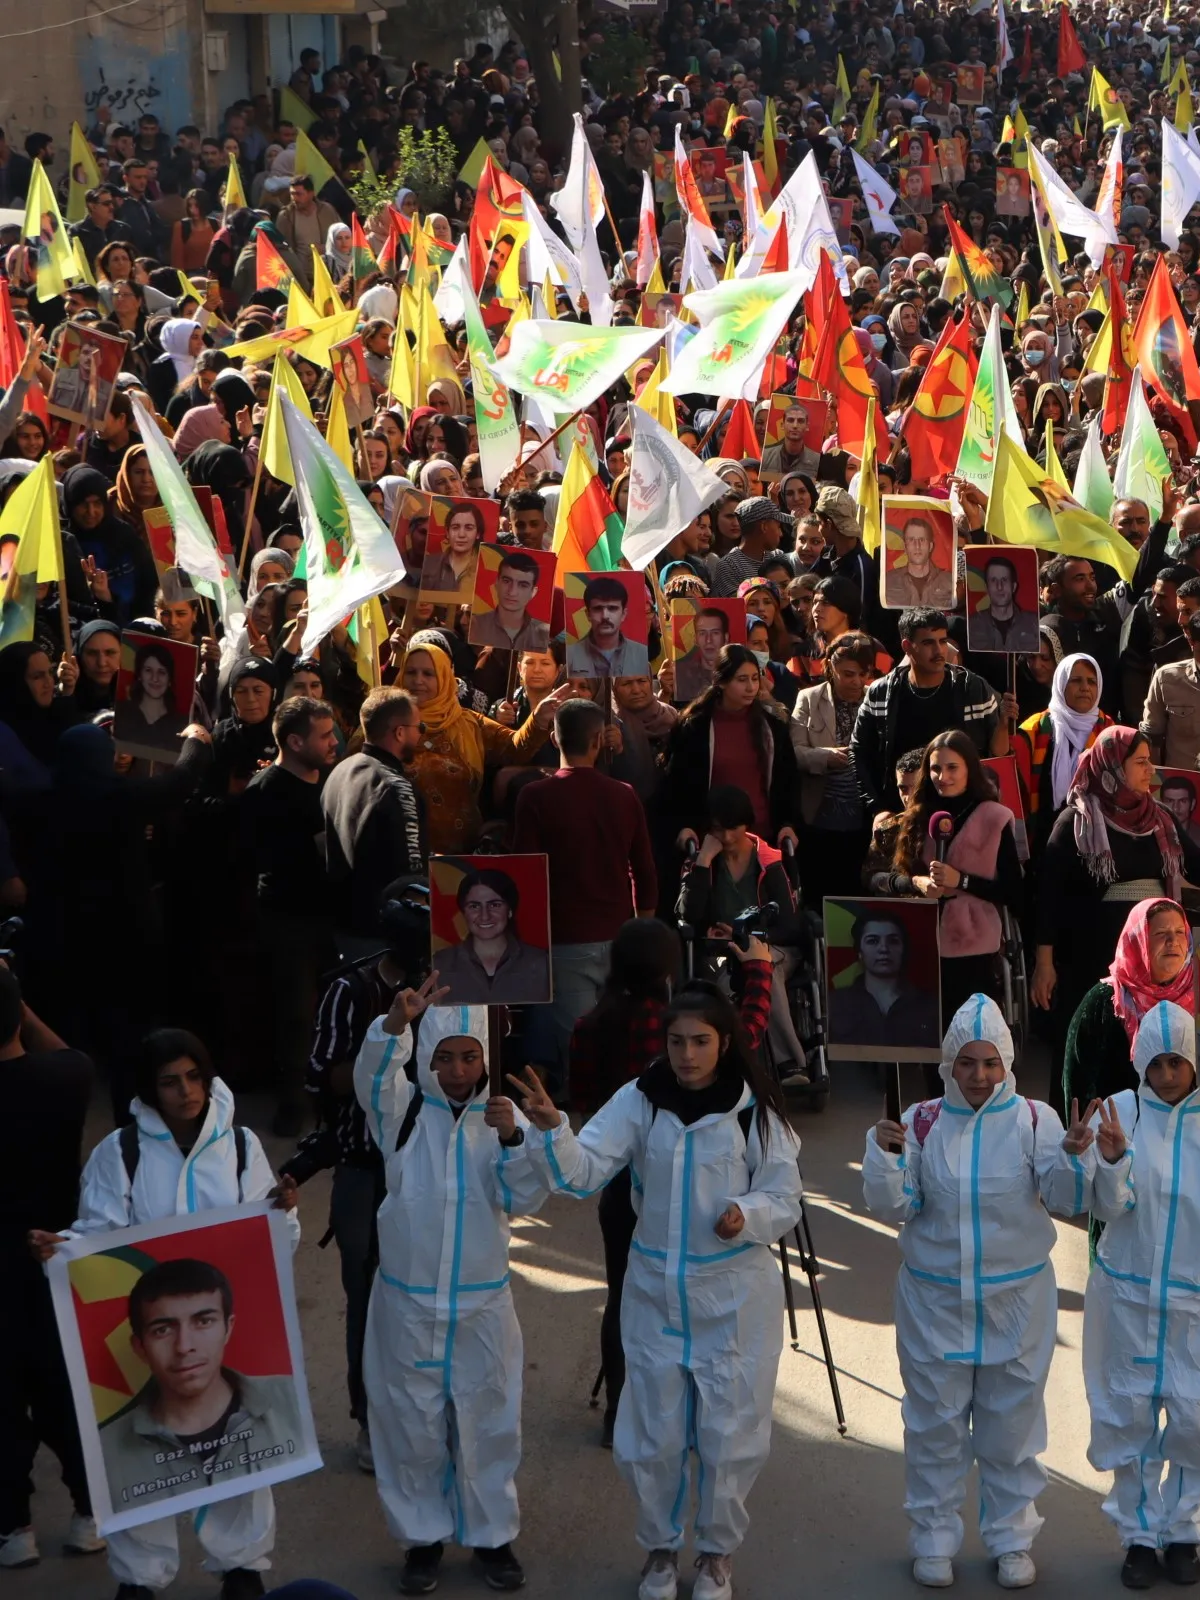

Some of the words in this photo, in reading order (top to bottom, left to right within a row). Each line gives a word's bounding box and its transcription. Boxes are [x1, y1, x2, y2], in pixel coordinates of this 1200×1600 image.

[154, 1448, 184, 1465] Baz
[189, 1428, 253, 1454] Mordem
[133, 1468, 197, 1497] Mehmet
[202, 1458, 233, 1475] Can
[239, 1443, 284, 1465] Evren
